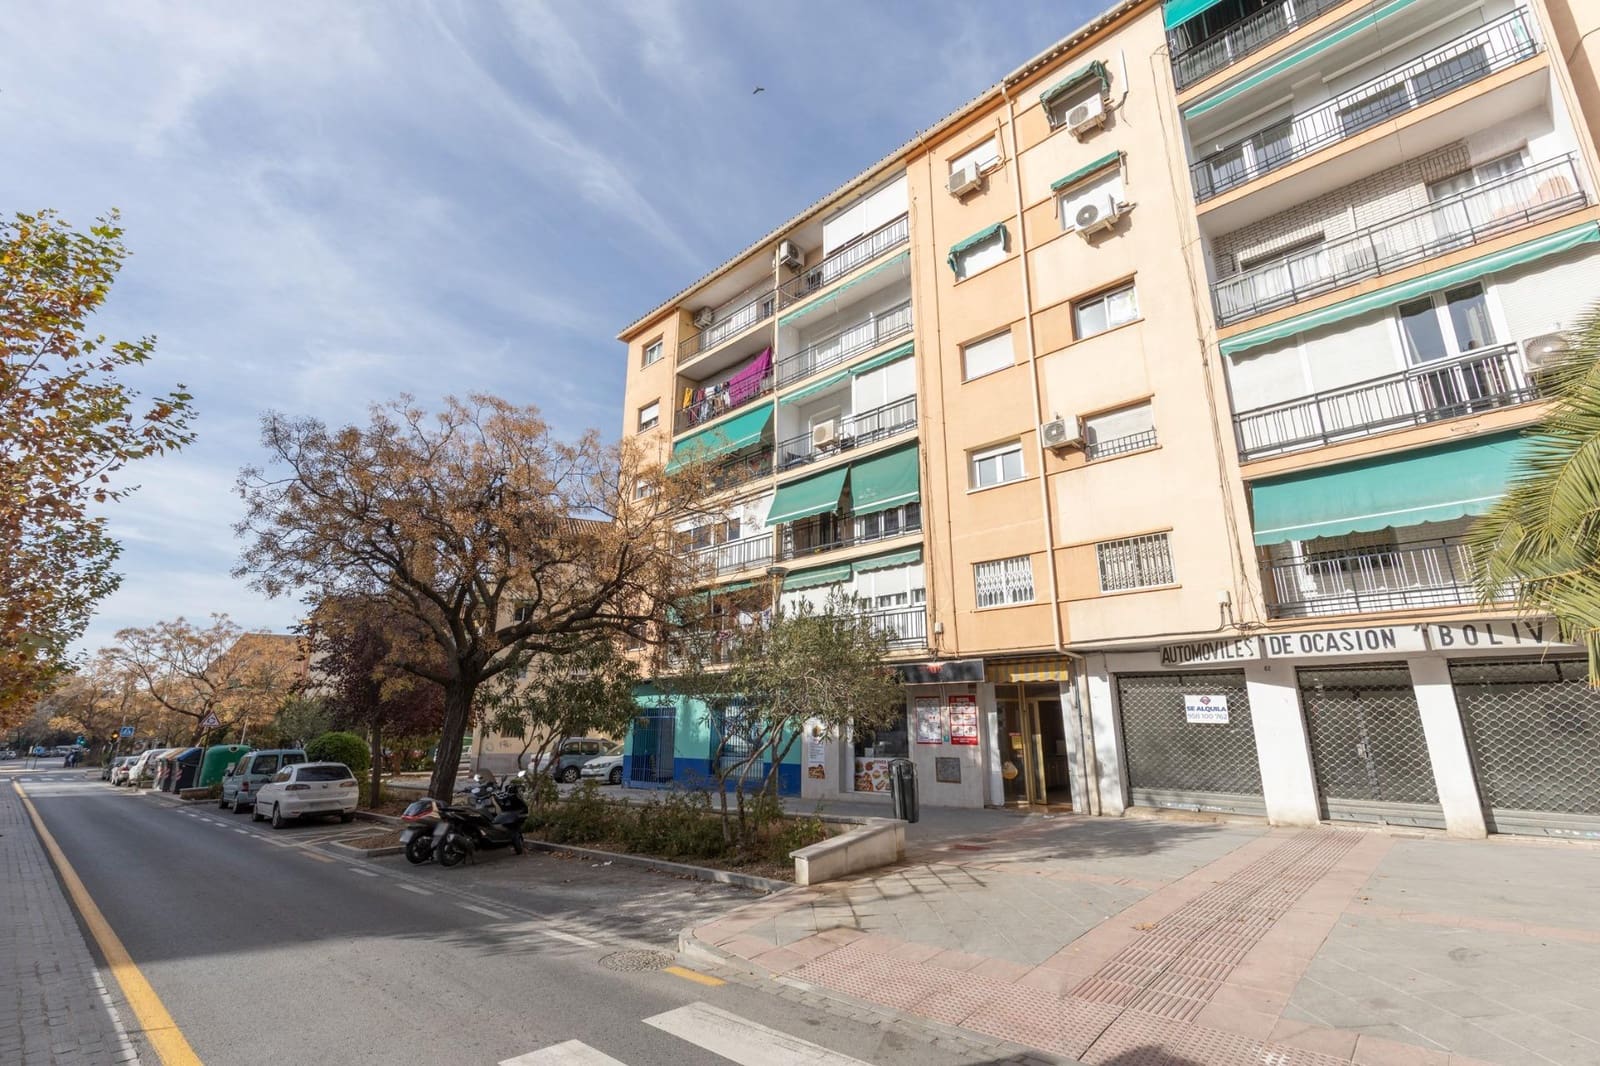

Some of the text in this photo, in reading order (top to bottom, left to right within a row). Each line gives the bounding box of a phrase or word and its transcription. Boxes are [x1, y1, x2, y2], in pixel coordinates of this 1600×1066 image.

[1162, 639, 1254, 664] AUTOMOVILES
[1269, 635, 1294, 655] DE
[1300, 628, 1397, 654] OCASION
